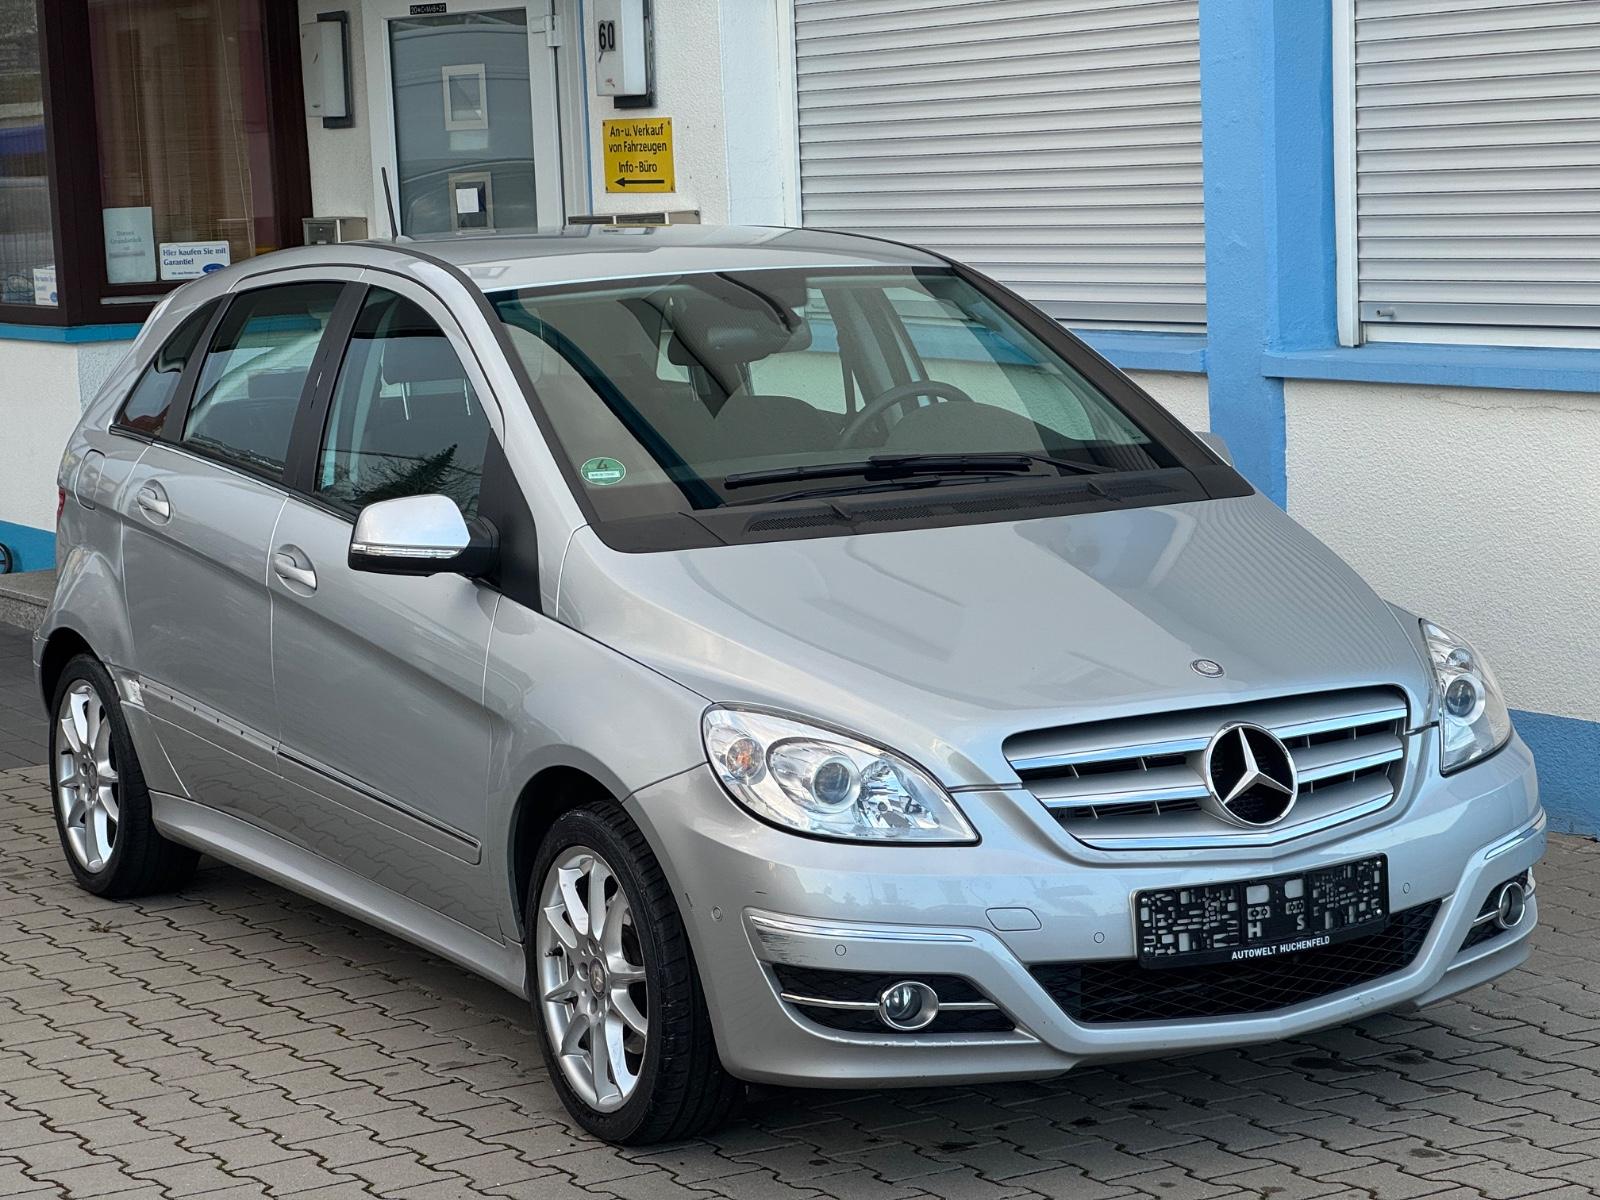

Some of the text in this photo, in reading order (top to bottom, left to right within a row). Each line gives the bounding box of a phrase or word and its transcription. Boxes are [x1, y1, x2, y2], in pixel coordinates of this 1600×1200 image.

[599, 23, 615, 50] 60
[632, 122, 664, 136] Verkauf
[608, 140, 667, 155] von Fahrzeugen
[163, 249, 177, 257] Hier
[178, 248, 202, 256] kaufen
[203, 247, 214, 255] Sie
[163, 258, 194, 266] Garantie!
[596, 459, 608, 471] 4
[1231, 936, 1330, 960] AUTOWELT HUCHENFELD
